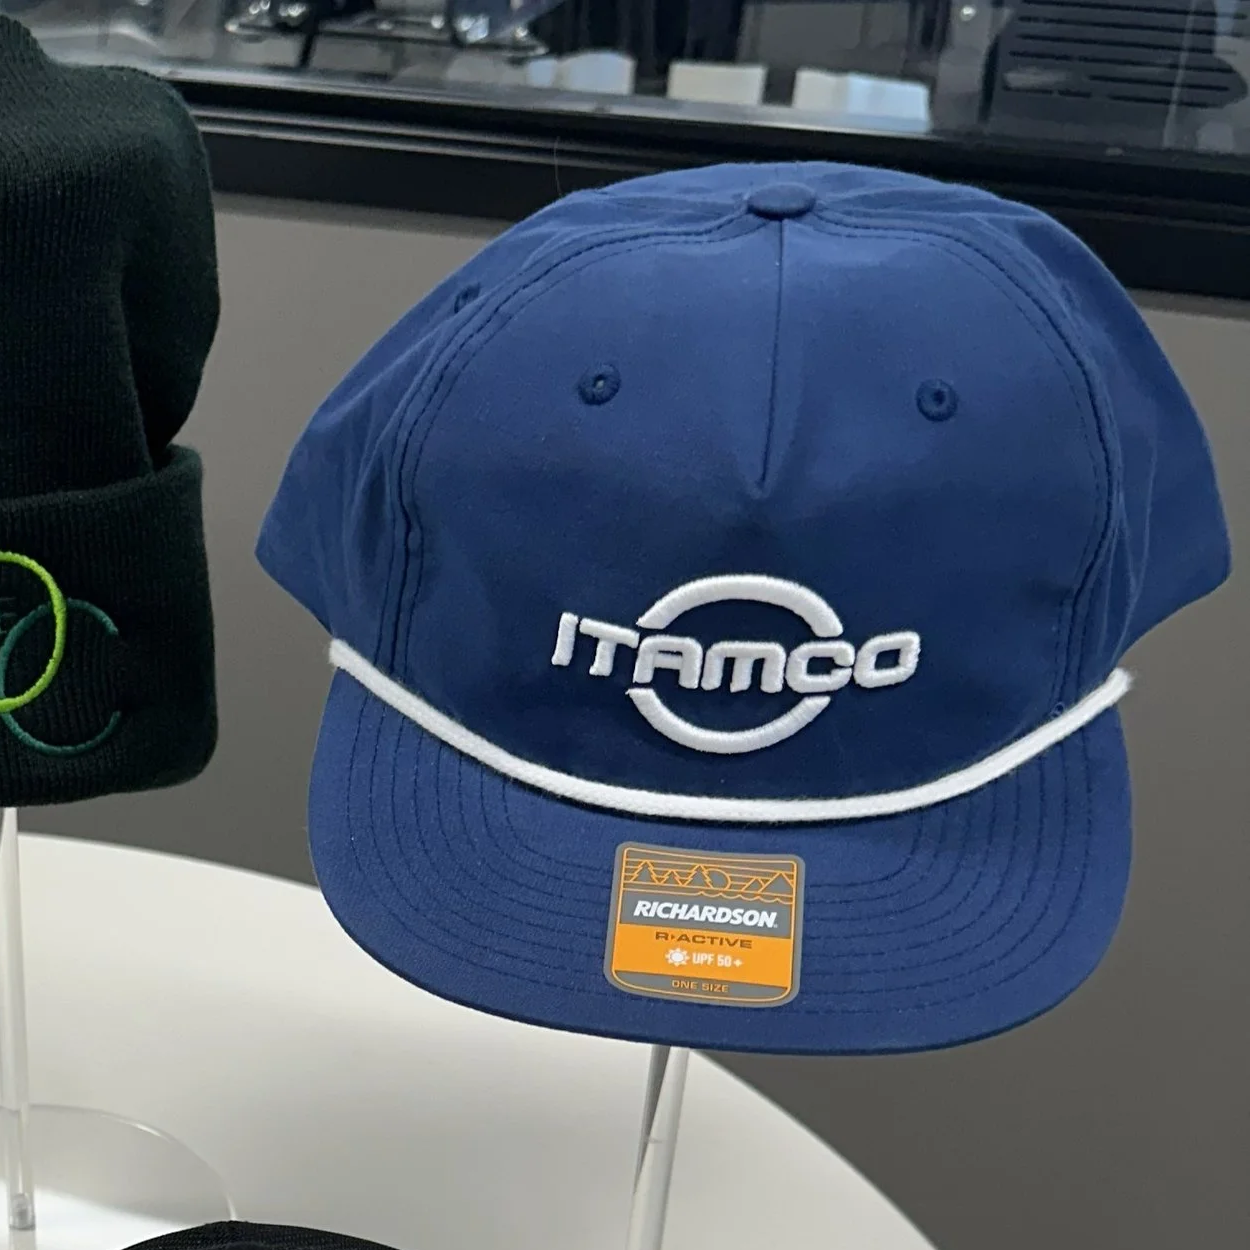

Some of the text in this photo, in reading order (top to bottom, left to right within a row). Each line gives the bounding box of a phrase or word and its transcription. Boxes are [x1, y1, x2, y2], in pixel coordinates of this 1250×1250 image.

[551, 612, 921, 694] ITAMCO
[633, 900, 778, 928] RICHARDSON
[692, 953, 714, 966] UPF
[671, 979, 730, 993] ONE SIZE
